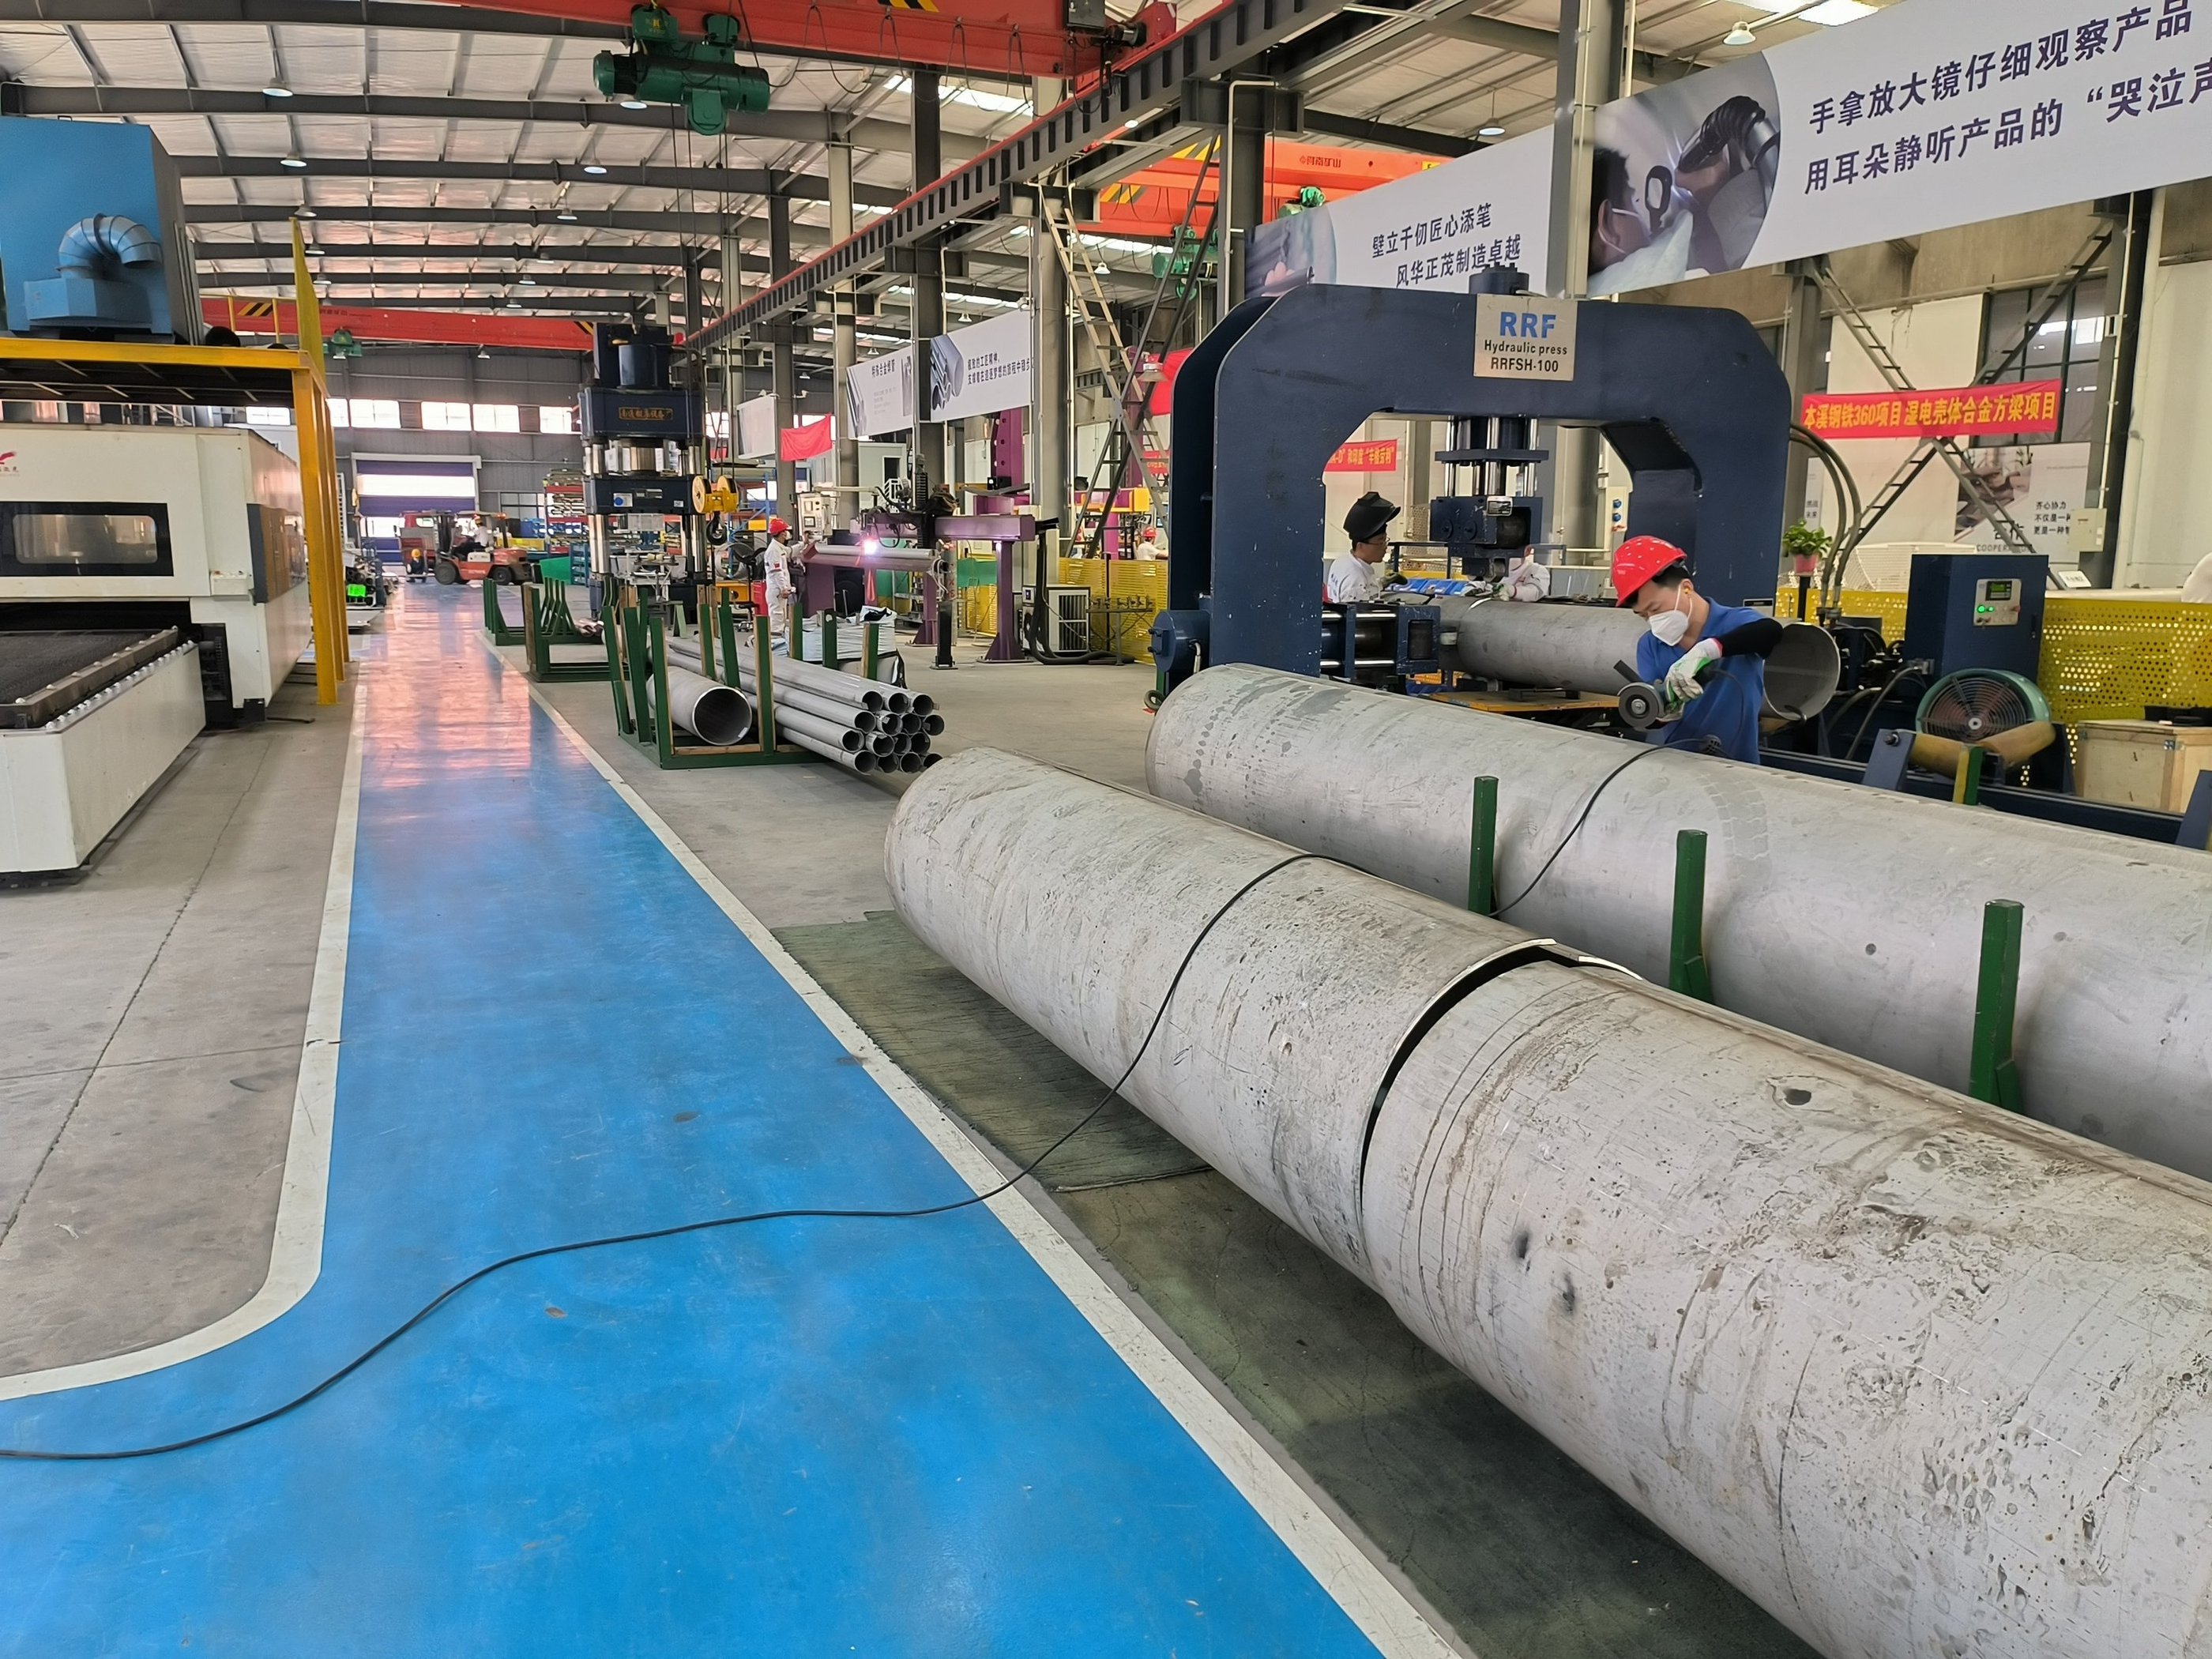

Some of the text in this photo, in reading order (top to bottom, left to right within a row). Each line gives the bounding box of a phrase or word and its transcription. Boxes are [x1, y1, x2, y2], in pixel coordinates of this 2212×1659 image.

[1809, 0, 2192, 134] 手拿放大镜仔细观察产品
[1372, 202, 1492, 258] 壁立千仞匠心添笔
[1396, 234, 1521, 288] 风华正茂制造卓越
[1499, 311, 1556, 339] RRF
[1484, 339, 1567, 356] Hydraulic press
[1491, 357, 1559, 372] RRFSH-100
[1804, 401, 1902, 429] 本溪钢铁360项目
